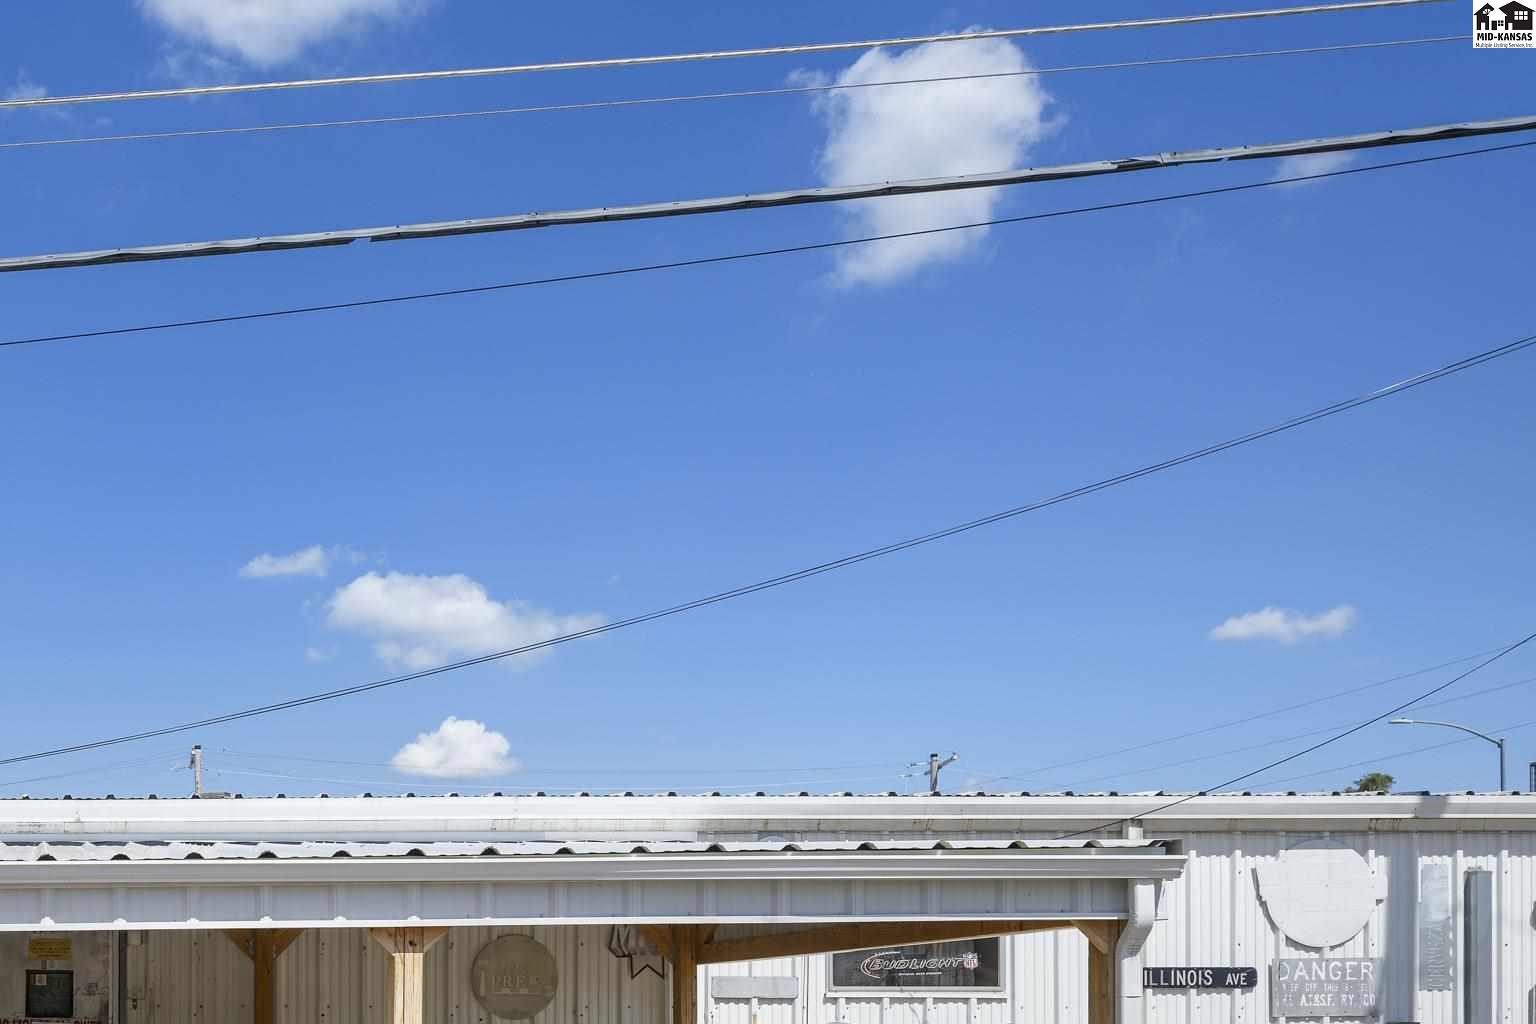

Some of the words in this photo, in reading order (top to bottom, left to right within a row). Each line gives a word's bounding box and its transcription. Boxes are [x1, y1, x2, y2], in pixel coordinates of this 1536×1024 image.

[1143, 969, 1213, 986] ILLINOIS
[1225, 973, 1248, 986] AVE
[1279, 961, 1374, 981] DANGER
